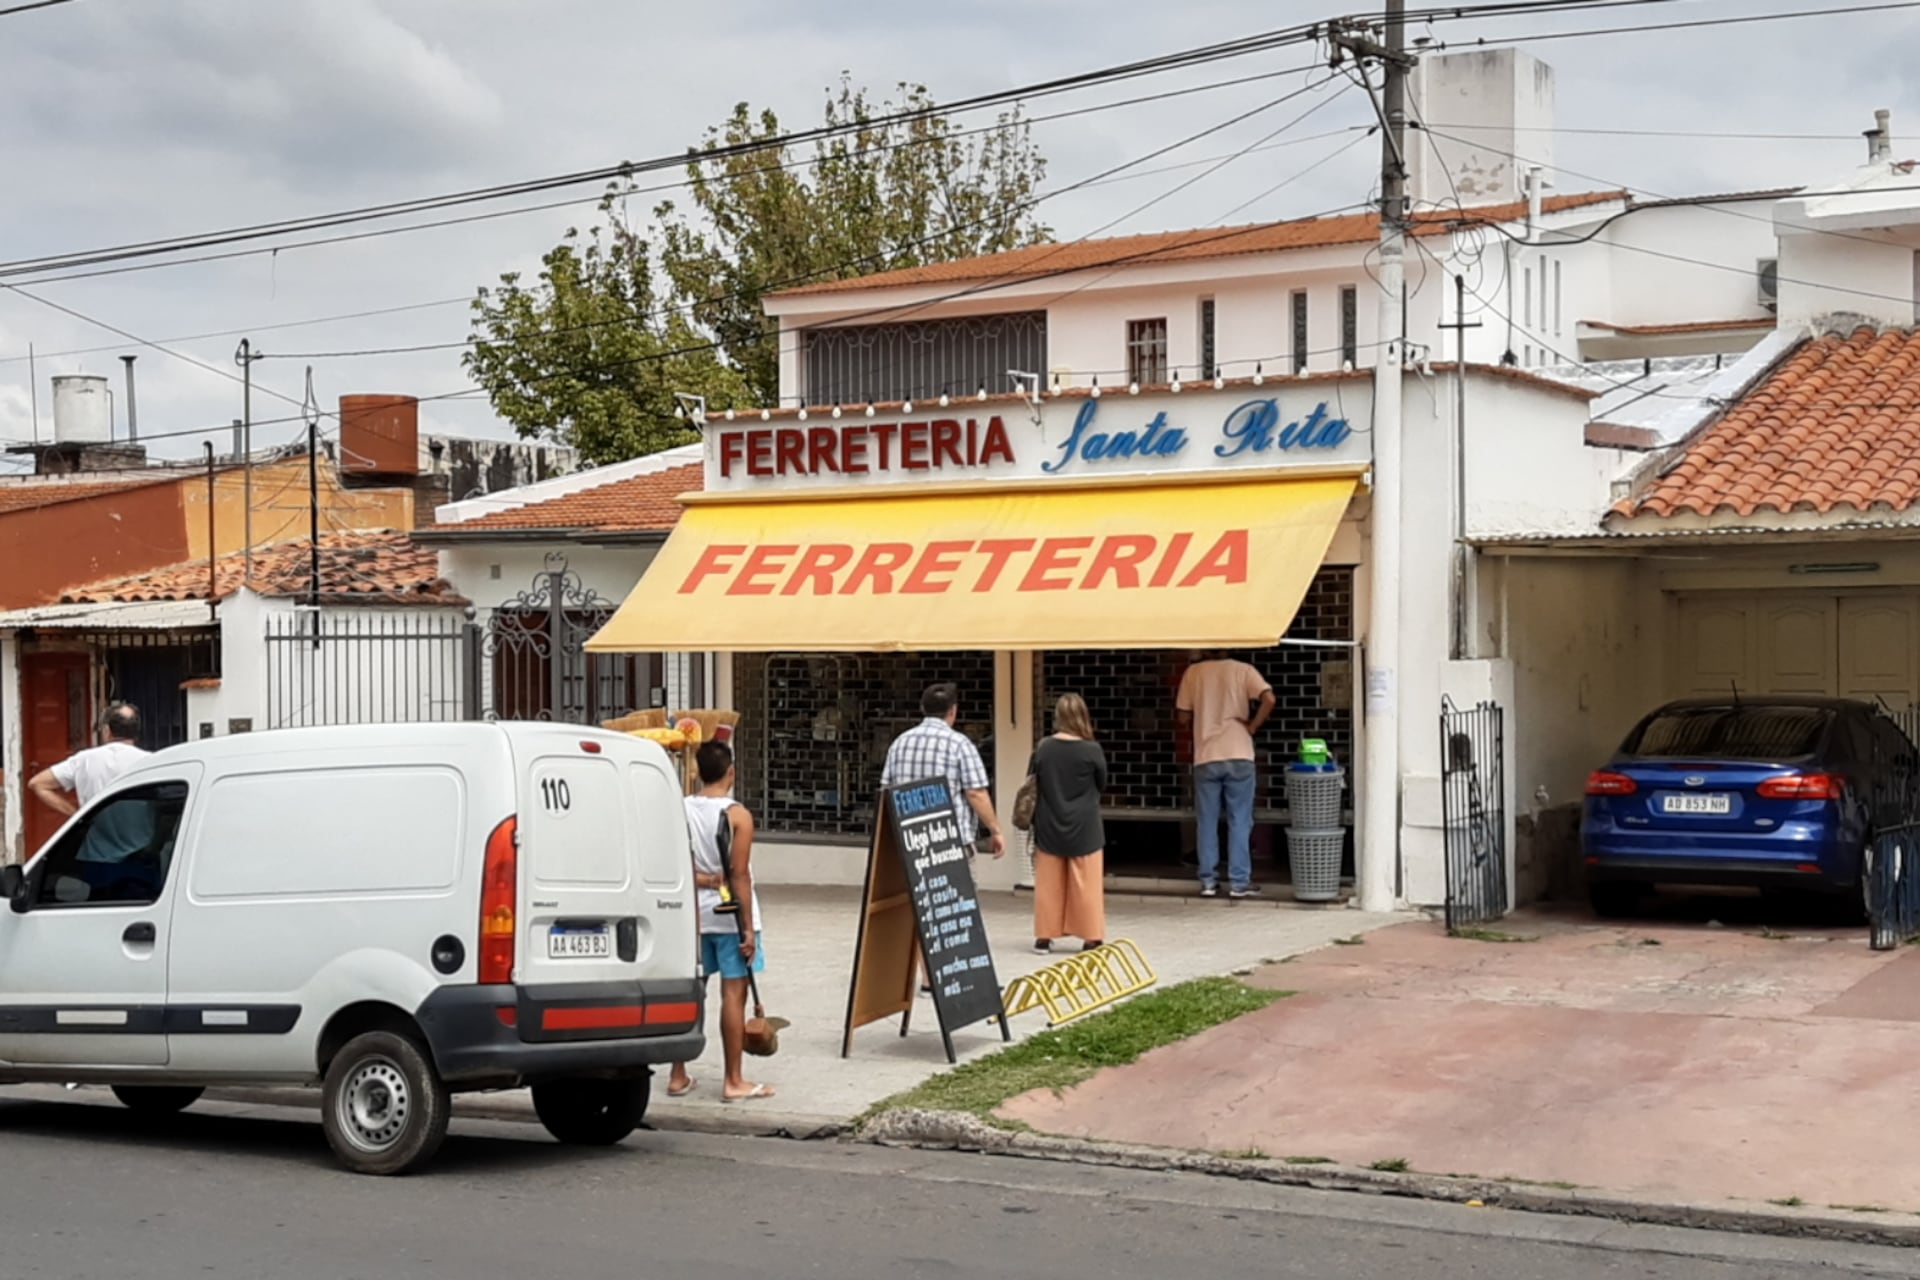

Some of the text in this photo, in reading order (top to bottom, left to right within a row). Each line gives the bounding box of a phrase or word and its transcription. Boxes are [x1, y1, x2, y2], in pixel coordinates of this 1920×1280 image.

[720, 416, 1015, 478] FERRETERIA
[1041, 398, 1352, 473] Santa Rita
[676, 528, 1249, 597] FERRETERIA
[541, 778, 570, 811] 110
[1667, 799, 1726, 811] AD 853 NH
[552, 936, 608, 954] AA 463 BJ
